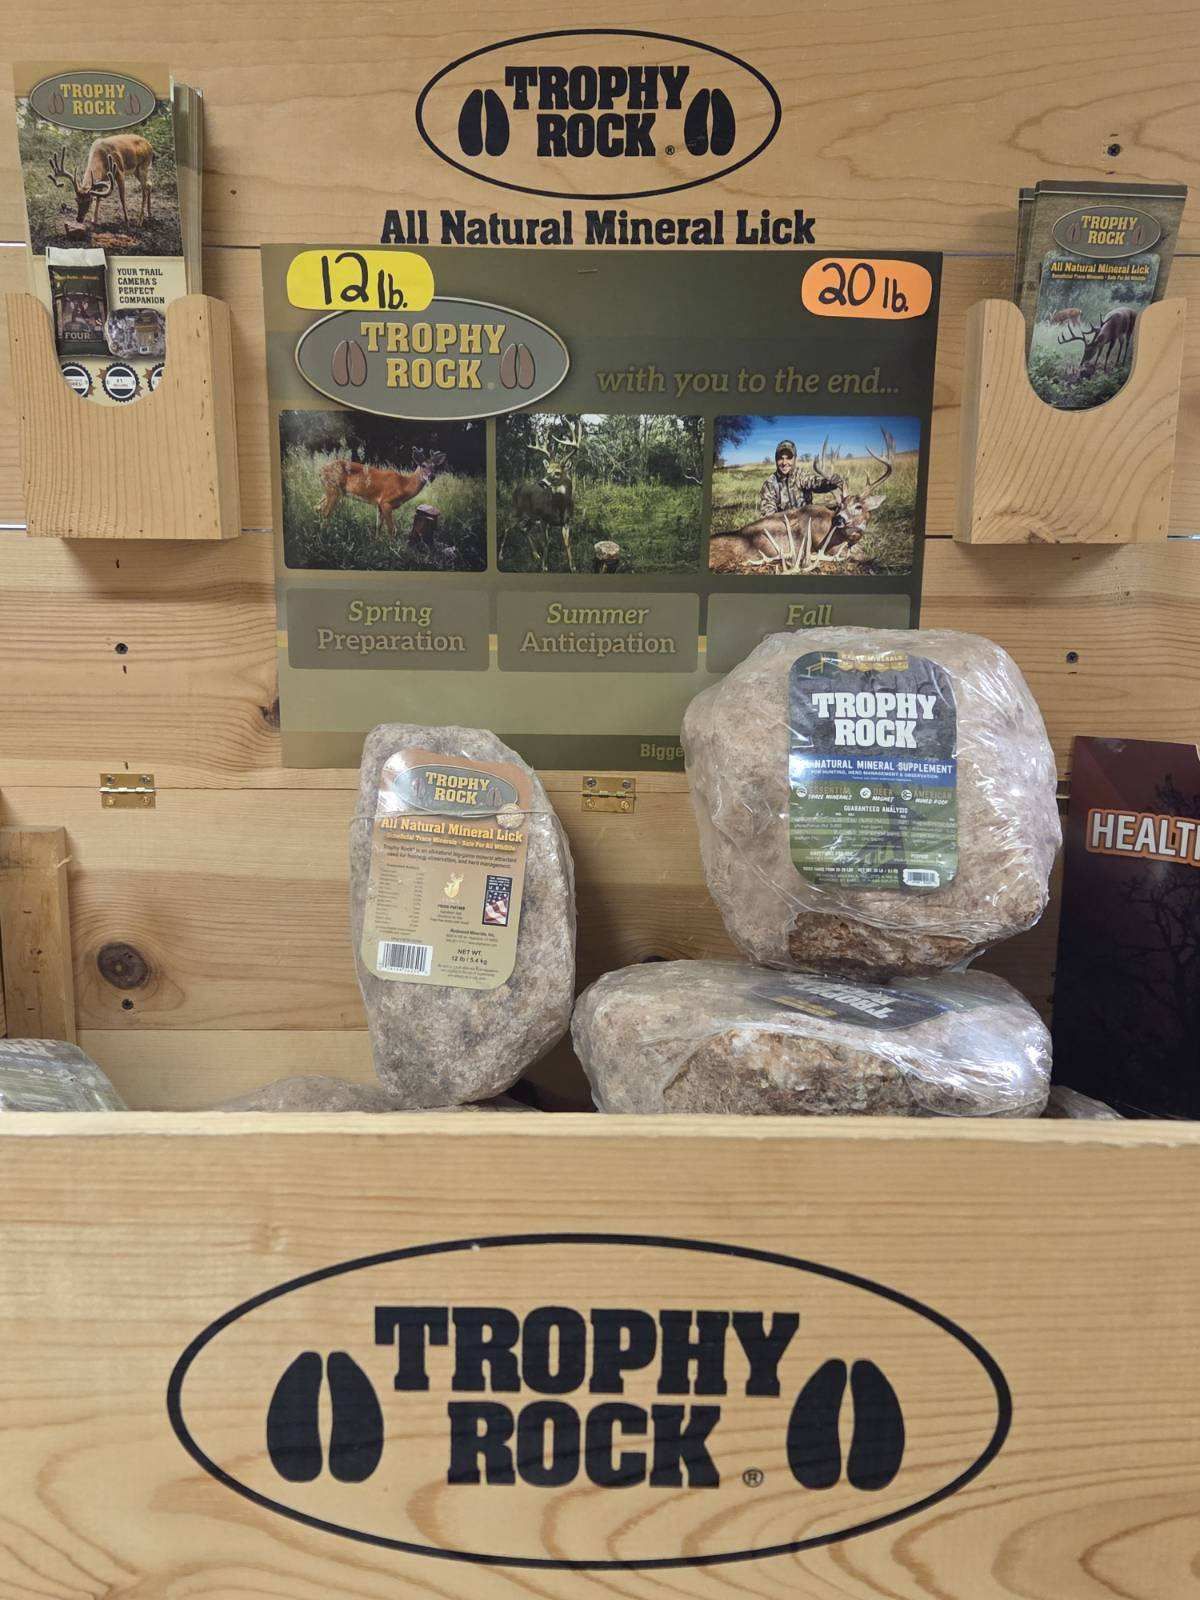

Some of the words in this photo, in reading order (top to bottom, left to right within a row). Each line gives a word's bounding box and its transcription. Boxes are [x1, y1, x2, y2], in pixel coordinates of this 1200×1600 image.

[60, 83, 125, 98] TROPHY
[505, 65, 690, 111] TROPHY
[72, 100, 116, 115] ROCK
[536, 112, 657, 158] ROCK
[381, 209, 429, 245] All
[441, 209, 573, 245] Natural
[585, 209, 724, 246] Mineral
[736, 209, 816, 246] Lick
[1081, 215, 1138, 230] TROPHY
[1087, 230, 1125, 245] ROCK
[117, 268, 137, 276] YOUR
[139, 268, 163, 276] TRAIL
[321, 252, 369, 305] 12
[1051, 261, 1063, 271] All
[1064, 261, 1096, 273] Natural
[1098, 263, 1131, 274] Mineral
[1131, 264, 1150, 274] Lick
[118, 277, 157, 285] CAMERA'S
[818, 262, 876, 307] 20
[119, 296, 165, 304] COMPANION
[360, 321, 507, 354] TROPHY
[386, 357, 483, 390] ROCK
[597, 366, 667, 394] with
[674, 371, 729, 398] you
[737, 368, 764, 394] to
[775, 366, 820, 394] the
[827, 368, 899, 394] end...
[348, 600, 433, 627] Spring
[546, 603, 650, 625] Summer
[786, 604, 833, 626] Fall
[317, 629, 466, 655] Preparation
[519, 631, 677, 657] Anticipation
[811, 692, 937, 720] TROPHY
[834, 719, 918, 749] ROCK
[856, 760, 895, 771] MINERAL
[898, 761, 953, 774] SUPPLEMENT
[426, 771, 490, 791] TROPHY
[434, 787, 478, 805] ROCK
[381, 815, 398, 829] All
[400, 815, 446, 834] Natural
[448, 823, 494, 840] Mineral
[496, 828, 523, 843] Lick
[374, 1306, 800, 1398] TROPHY
[447, 1400, 721, 1488] ROCK
